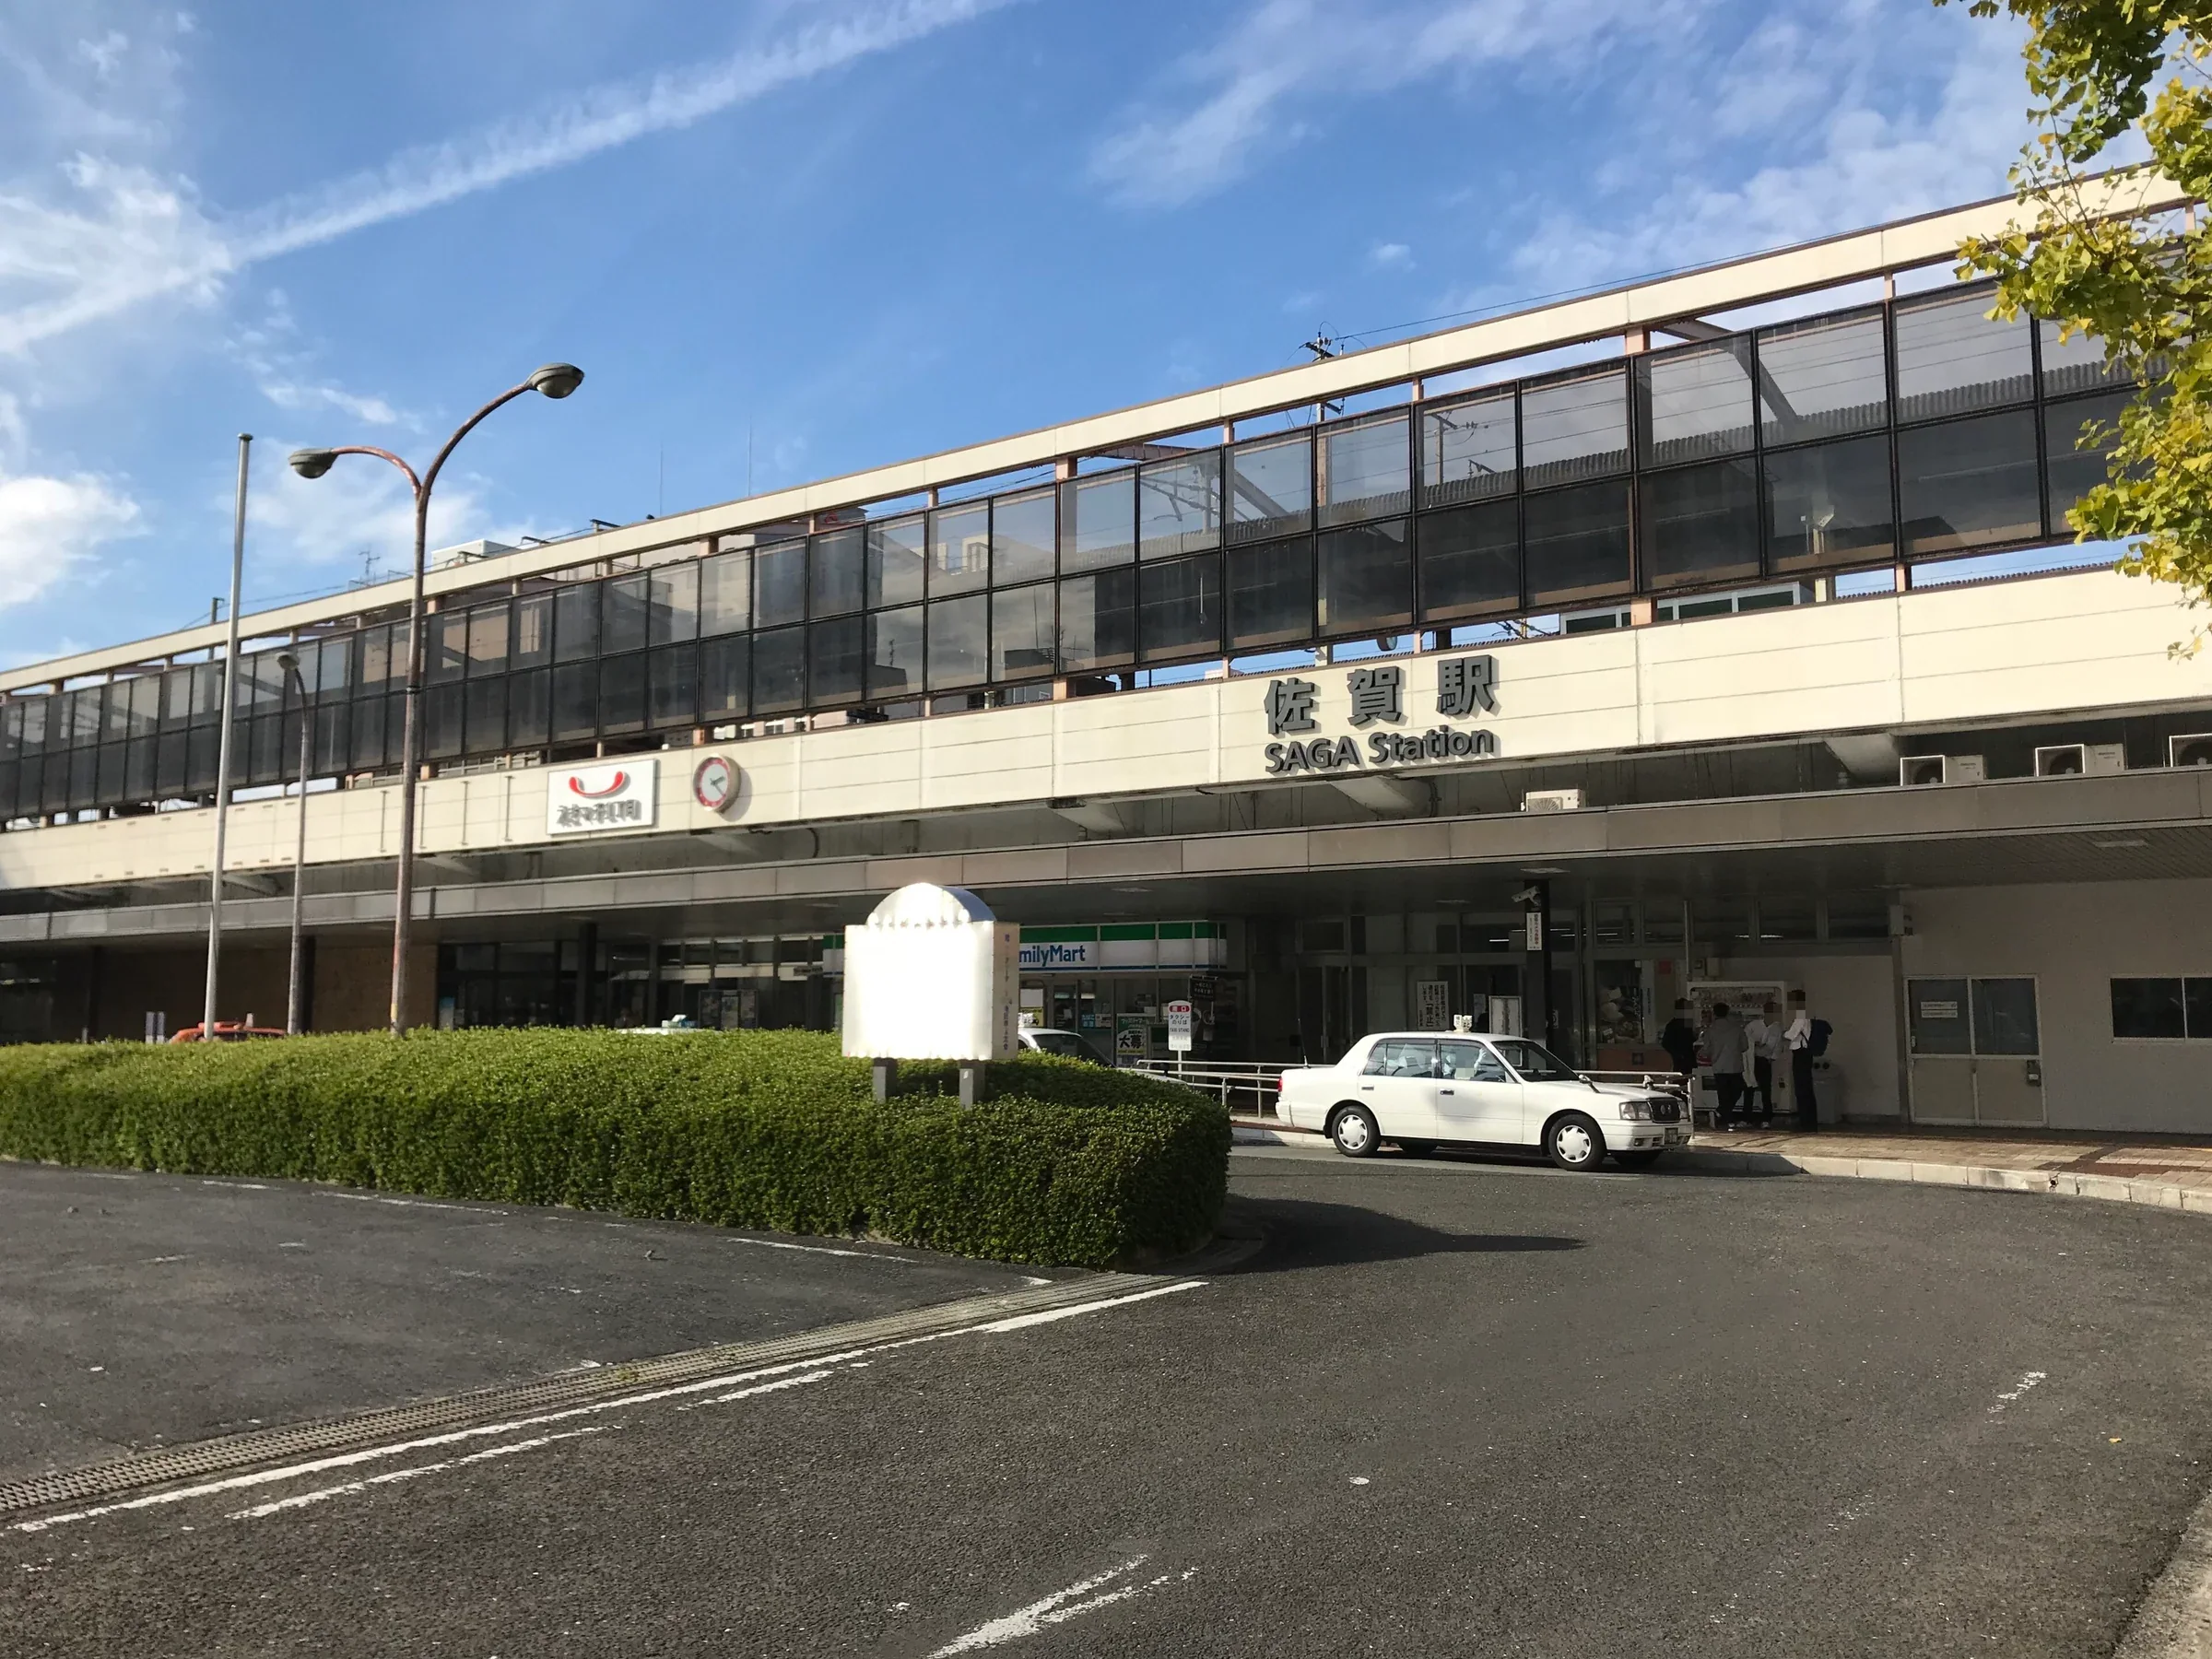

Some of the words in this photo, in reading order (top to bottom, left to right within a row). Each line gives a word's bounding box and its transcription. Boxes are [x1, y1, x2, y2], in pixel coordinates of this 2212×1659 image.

[1264, 654, 1495, 735] 佐賀駅
[1265, 736, 1359, 773] SAGA
[1369, 725, 1494, 763] Station
[1019, 945, 1086, 967] milyMart
[1119, 1034, 1145, 1049] 大募
